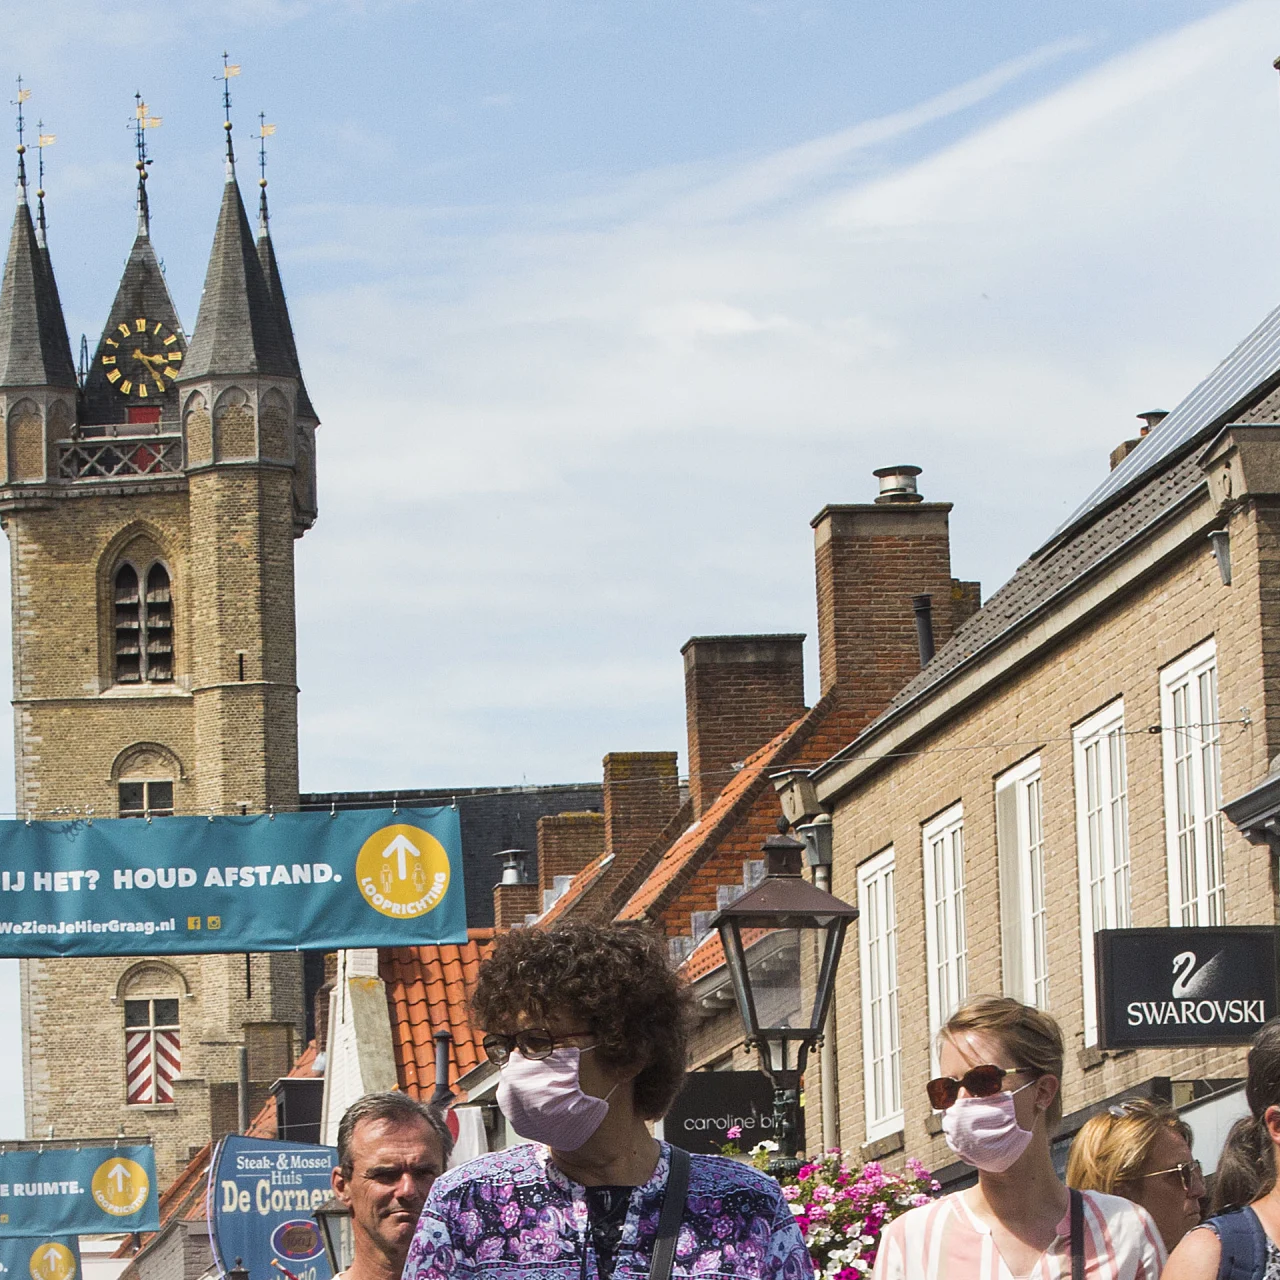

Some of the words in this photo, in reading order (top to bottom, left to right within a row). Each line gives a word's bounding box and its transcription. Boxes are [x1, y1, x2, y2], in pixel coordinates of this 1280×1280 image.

[33, 869, 100, 893] HET?
[113, 867, 198, 890] HOUD
[203, 863, 342, 888] AFSTAND.
[361, 872, 447, 915] LOOPRICHTING
[1127, 1000, 1266, 1026] SWAROVSKI
[683, 1114, 756, 1131] caroline
[236, 1155, 274, 1170] Steak-
[276, 1153, 290, 1171] &
[290, 1155, 332, 1169] Mossel
[13, 1181, 85, 1196] RUIMTE.
[270, 1170, 303, 1185] Huis
[221, 1180, 251, 1213] De
